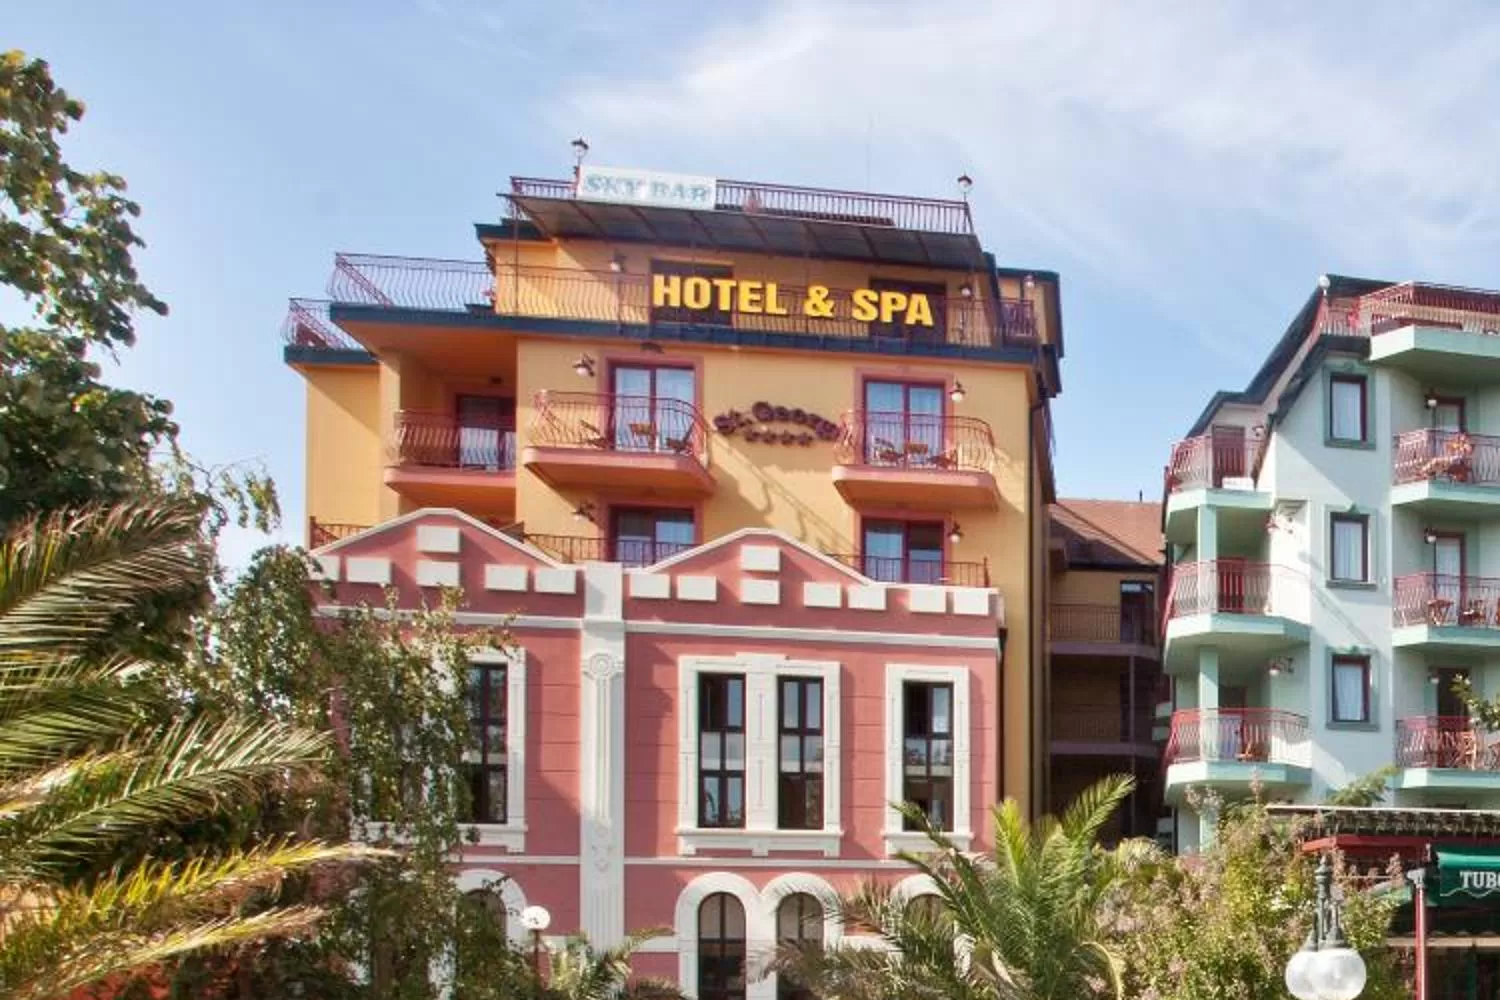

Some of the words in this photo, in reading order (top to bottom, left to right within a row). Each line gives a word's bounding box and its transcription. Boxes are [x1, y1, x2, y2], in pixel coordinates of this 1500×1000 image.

[586, 173, 644, 196] SKY
[651, 180, 710, 202] BAR
[652, 274, 788, 315] HOTEL
[803, 284, 836, 318] &
[851, 287, 934, 327] SPA
